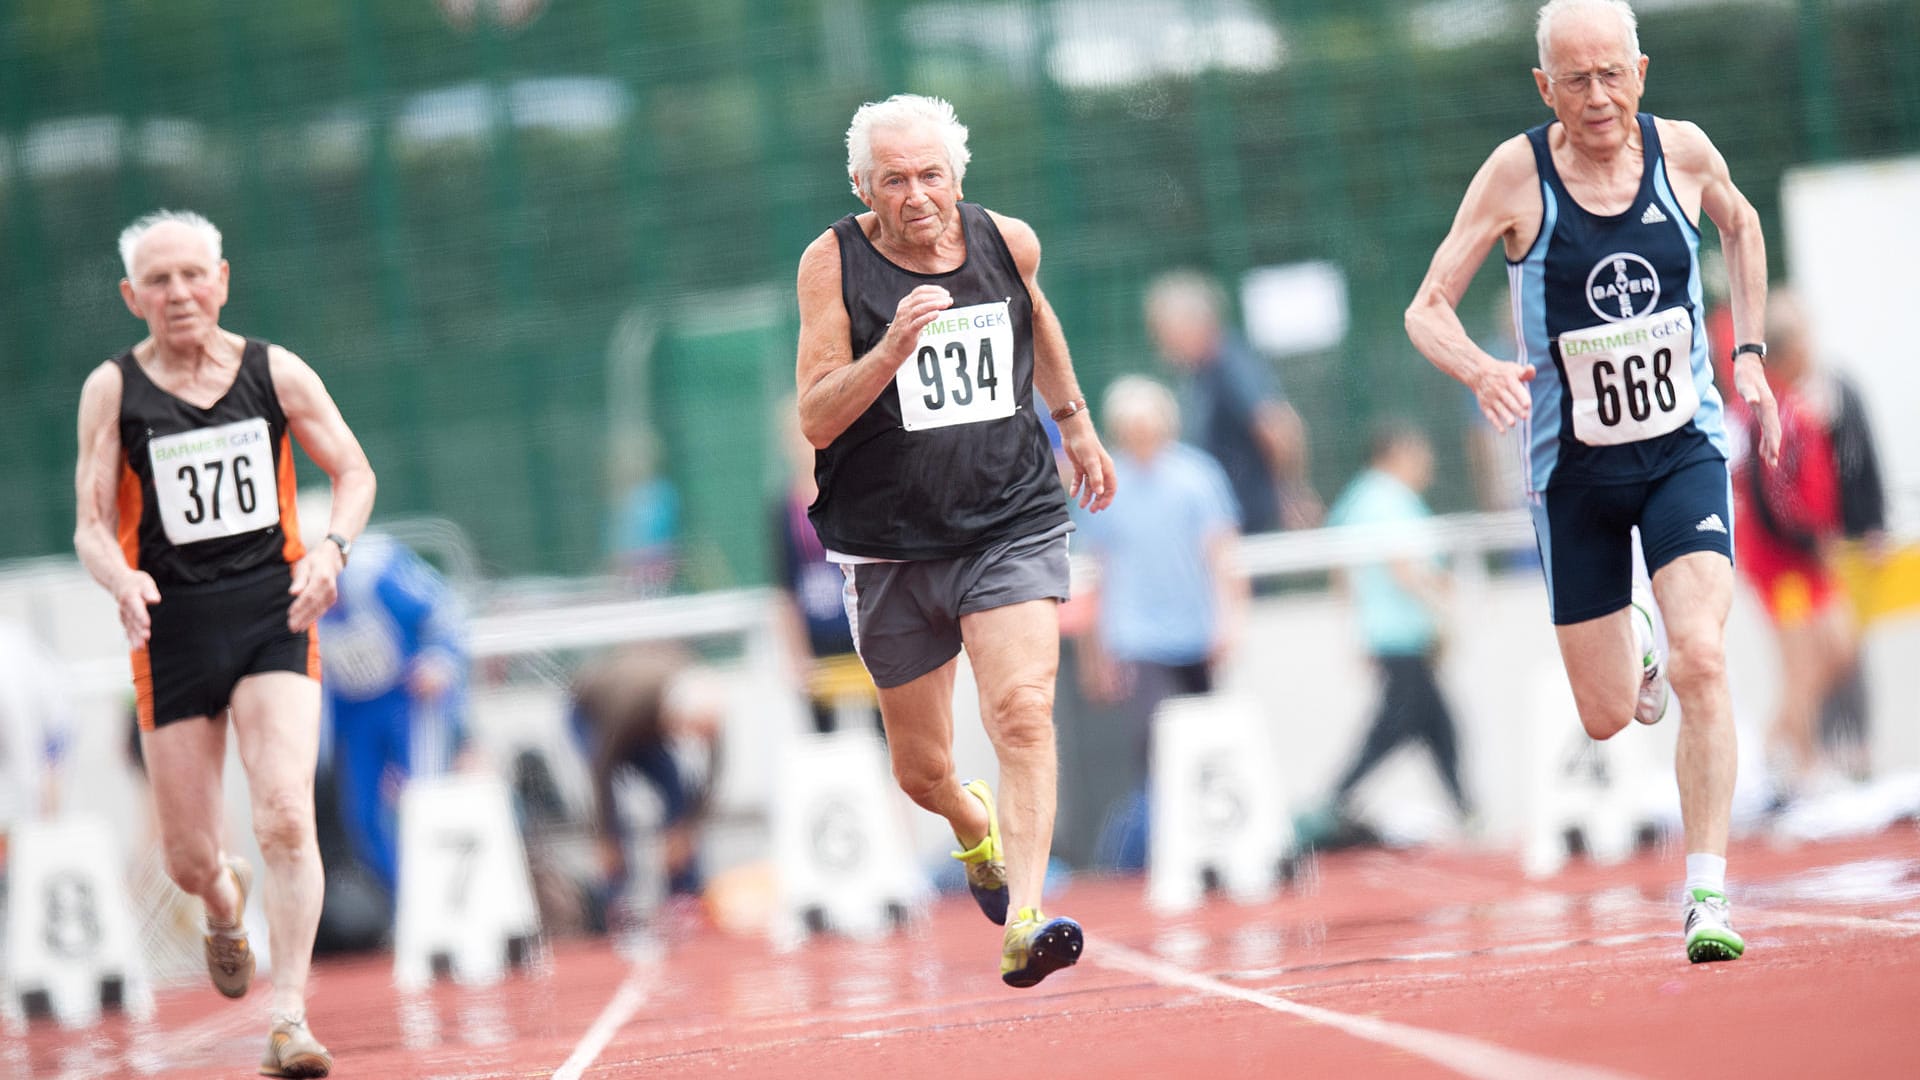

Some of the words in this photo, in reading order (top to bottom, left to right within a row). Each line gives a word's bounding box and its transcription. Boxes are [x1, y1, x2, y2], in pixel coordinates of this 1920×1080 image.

[973, 313, 1006, 329] GEK
[1592, 277, 1654, 300] BAYER
[1613, 259, 1634, 318] BAYER
[1565, 328, 1649, 357] BARMER
[1652, 317, 1686, 339] GEK
[917, 337, 998, 411] 934
[1592, 347, 1677, 427] 668
[155, 435, 228, 461] BARMER
[229, 430, 263, 447] GEK
[178, 455, 256, 525] 376
[1195, 750, 1251, 833] 5
[430, 827, 485, 911] 7
[810, 791, 872, 875] 6
[43, 869, 102, 957] 8
